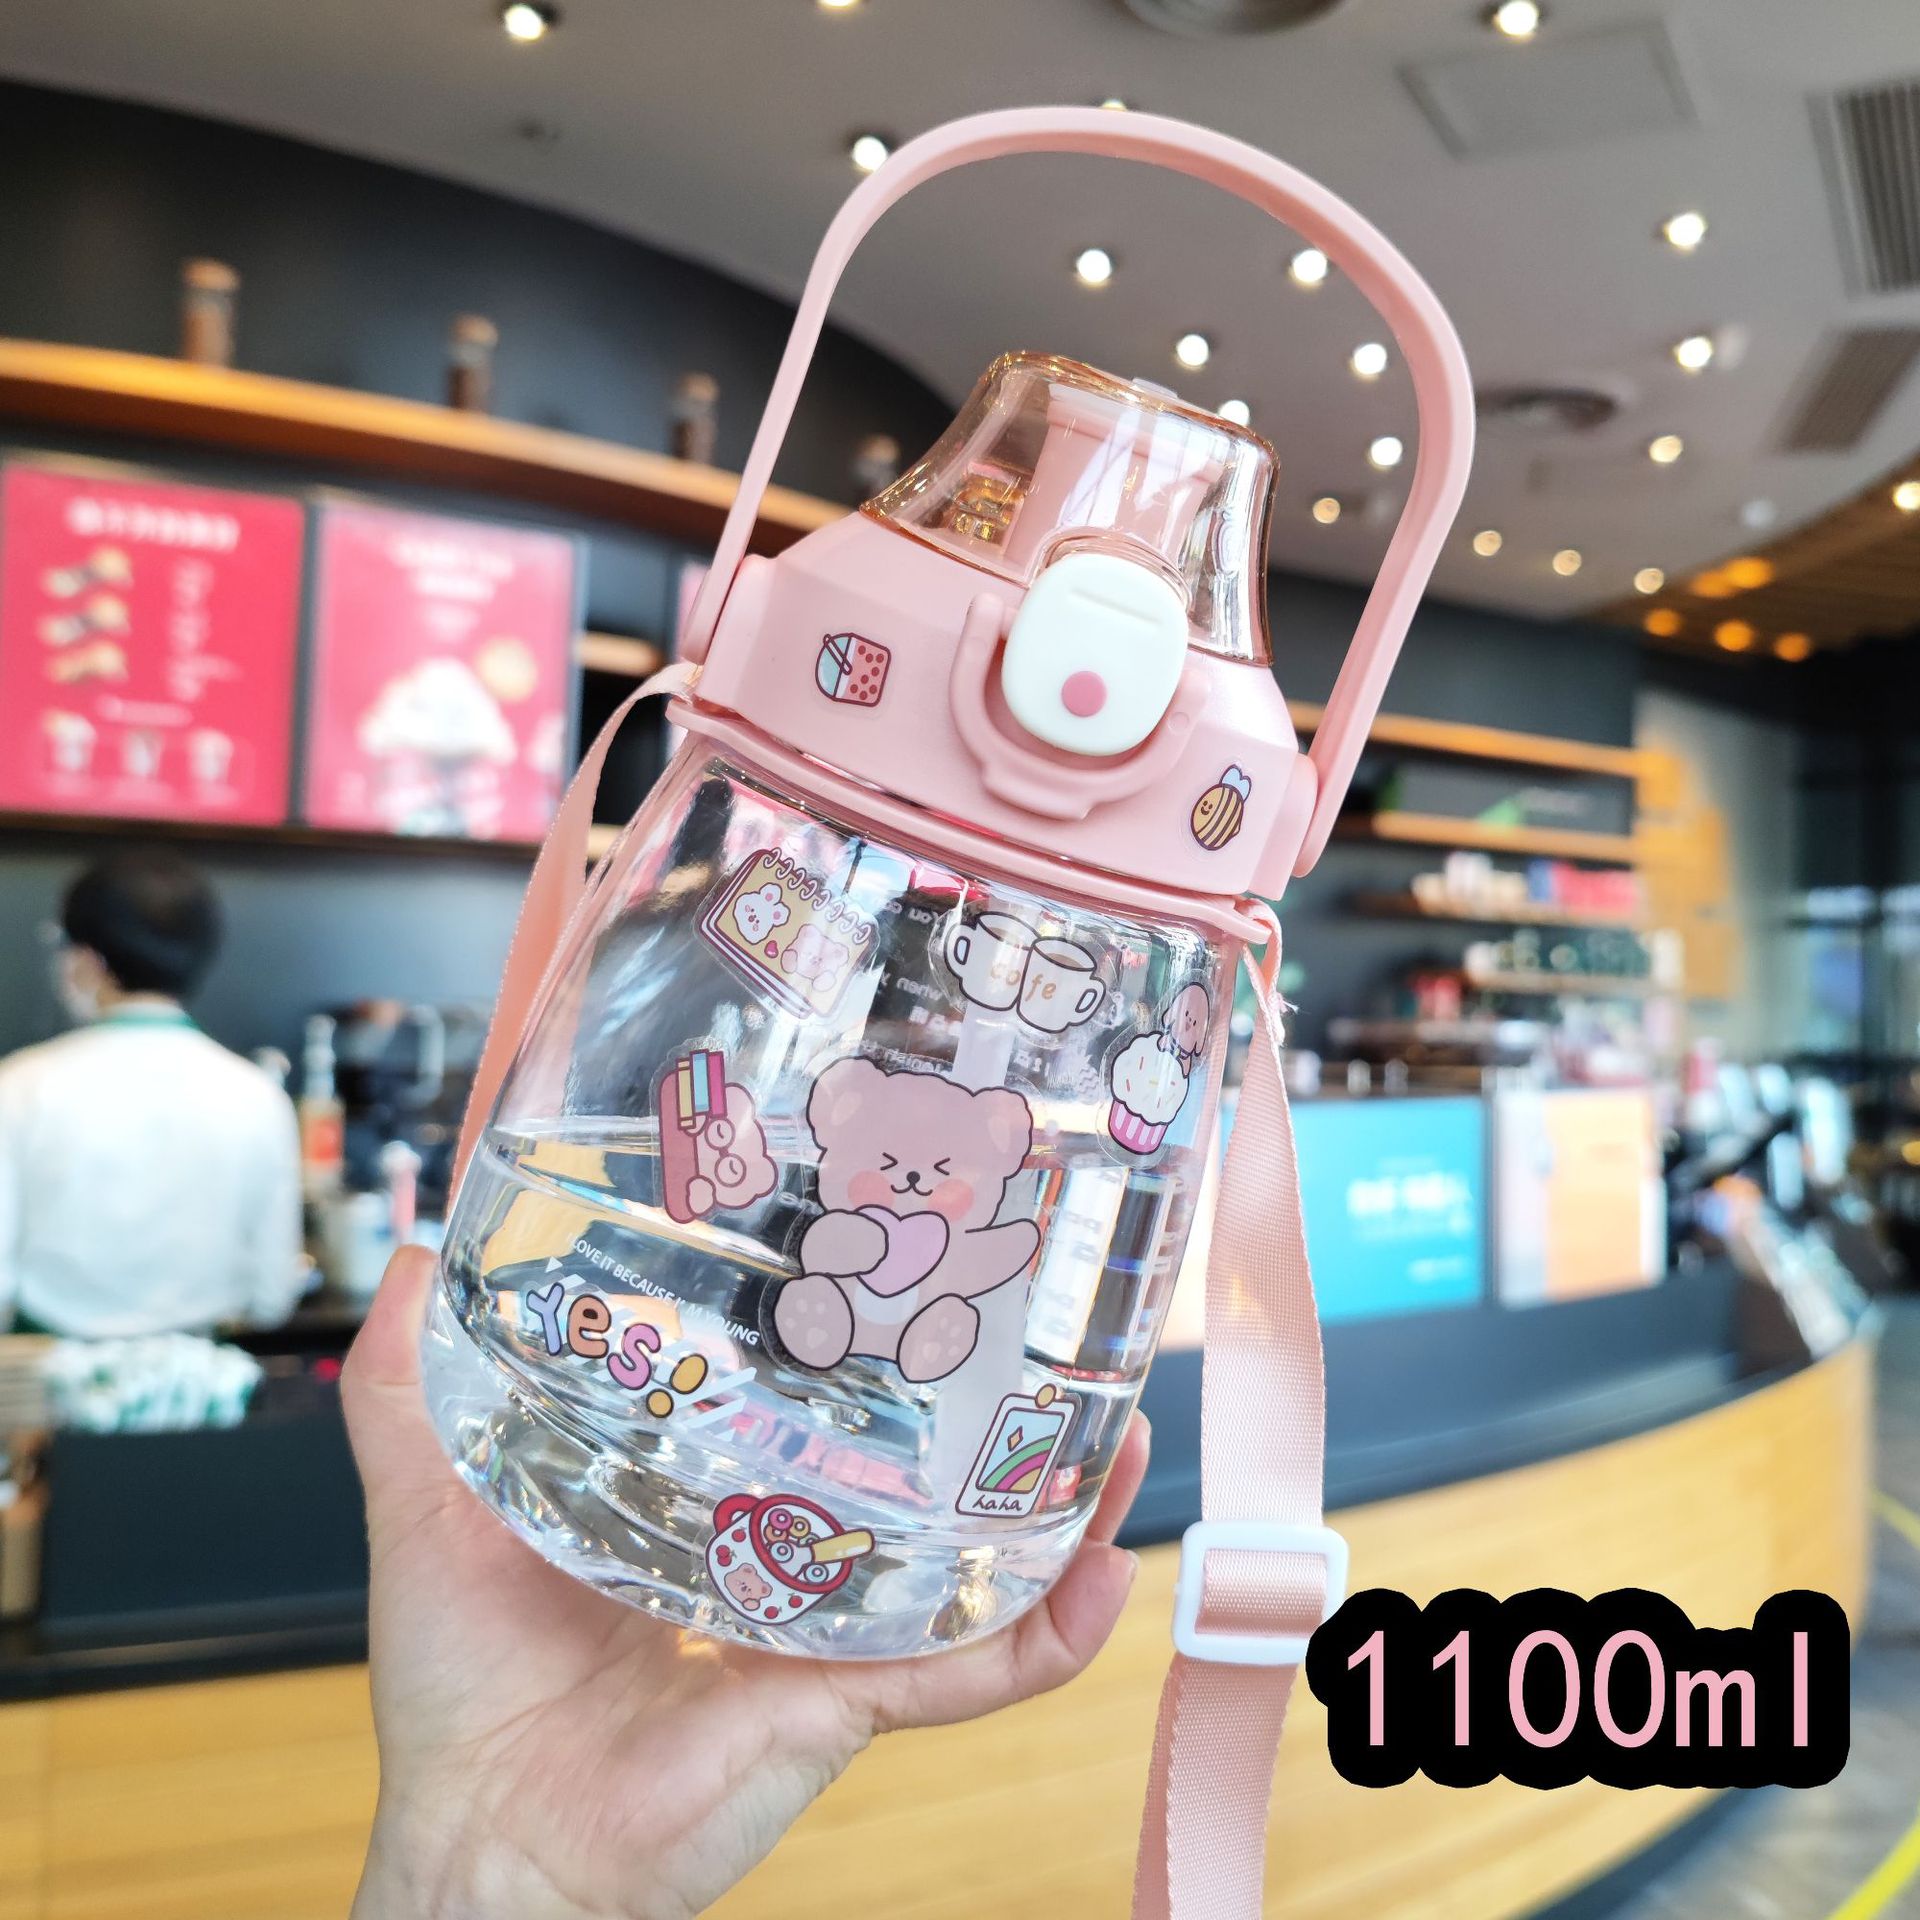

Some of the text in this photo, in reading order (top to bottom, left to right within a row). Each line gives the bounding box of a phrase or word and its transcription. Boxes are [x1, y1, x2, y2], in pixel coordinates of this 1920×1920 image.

[572, 1236, 603, 1265] LOVE
[599, 1255, 616, 1271] IT
[612, 1263, 676, 1305] BECAUSE
[705, 1309, 760, 1346] YOUNG
[525, 1281, 708, 1419] Yes!
[972, 1494, 1023, 1512] haha
